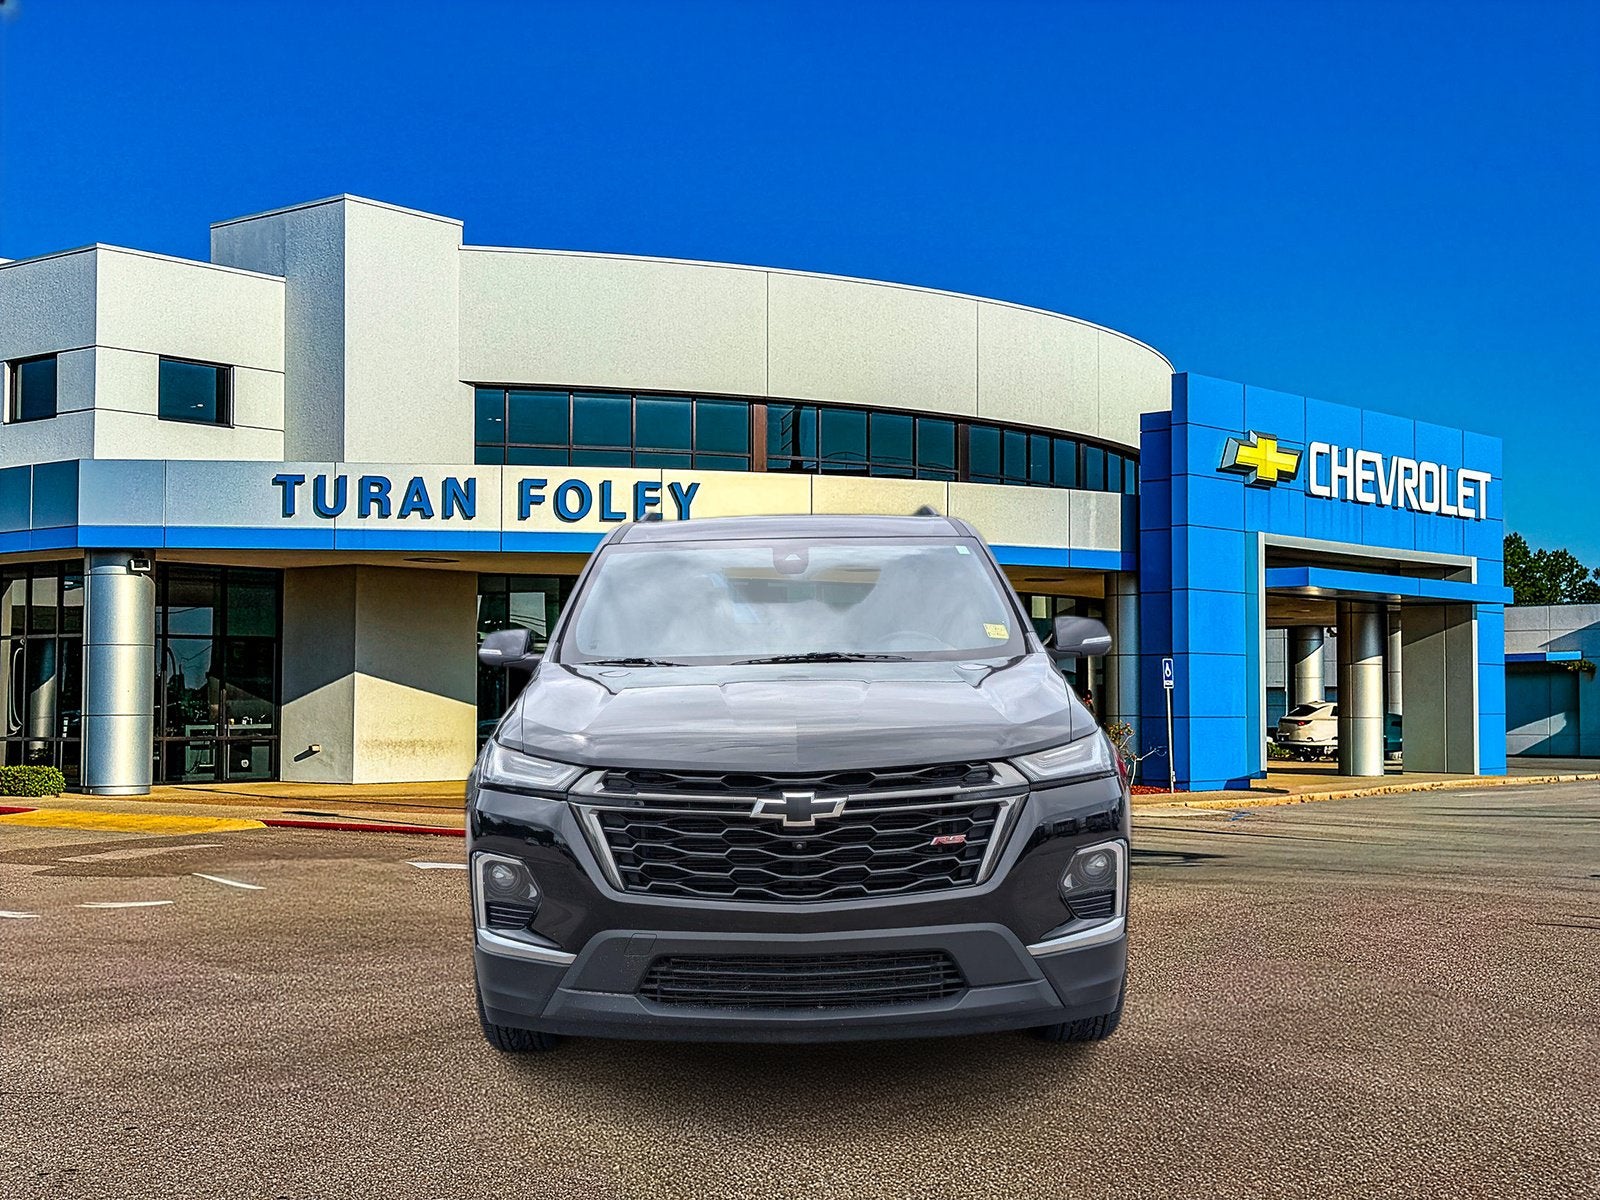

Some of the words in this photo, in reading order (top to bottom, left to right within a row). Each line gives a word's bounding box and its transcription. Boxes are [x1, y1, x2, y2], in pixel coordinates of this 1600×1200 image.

[272, 474, 476, 521] TURAN
[518, 478, 700, 523] FOLEY
[1308, 441, 1492, 520] CHEVROLET
